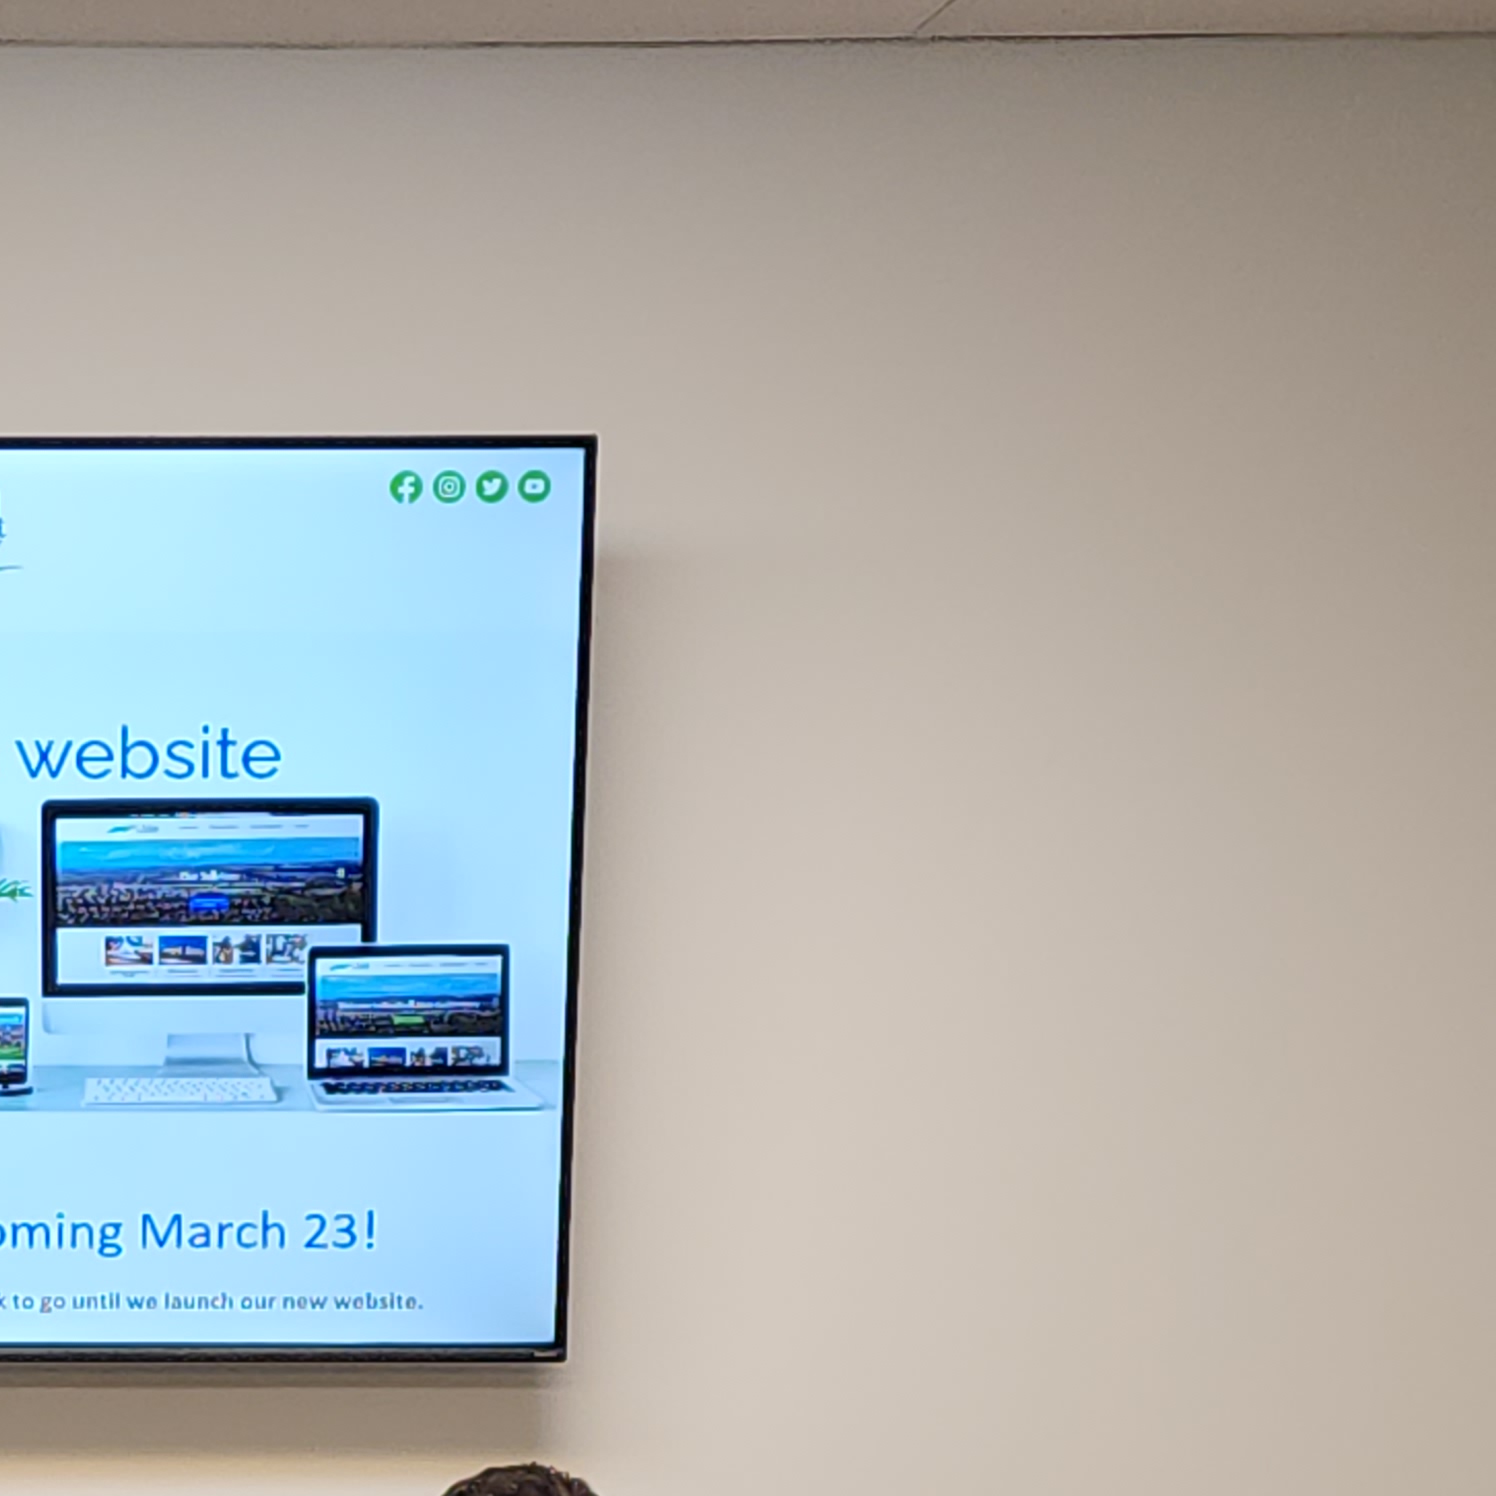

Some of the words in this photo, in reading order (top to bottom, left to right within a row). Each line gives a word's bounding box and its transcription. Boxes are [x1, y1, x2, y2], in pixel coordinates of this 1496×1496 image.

[15, 725, 282, 780] website
[140, 1210, 286, 1249] March
[303, 1210, 376, 1249] 23!
[12, 1293, 35, 1311] to
[40, 1296, 66, 1314] go
[72, 1292, 121, 1311] until
[126, 1296, 158, 1311] we
[164, 1292, 234, 1311] launch
[241, 1296, 275, 1311] our
[282, 1296, 327, 1311] new
[333, 1292, 424, 1311] website.
